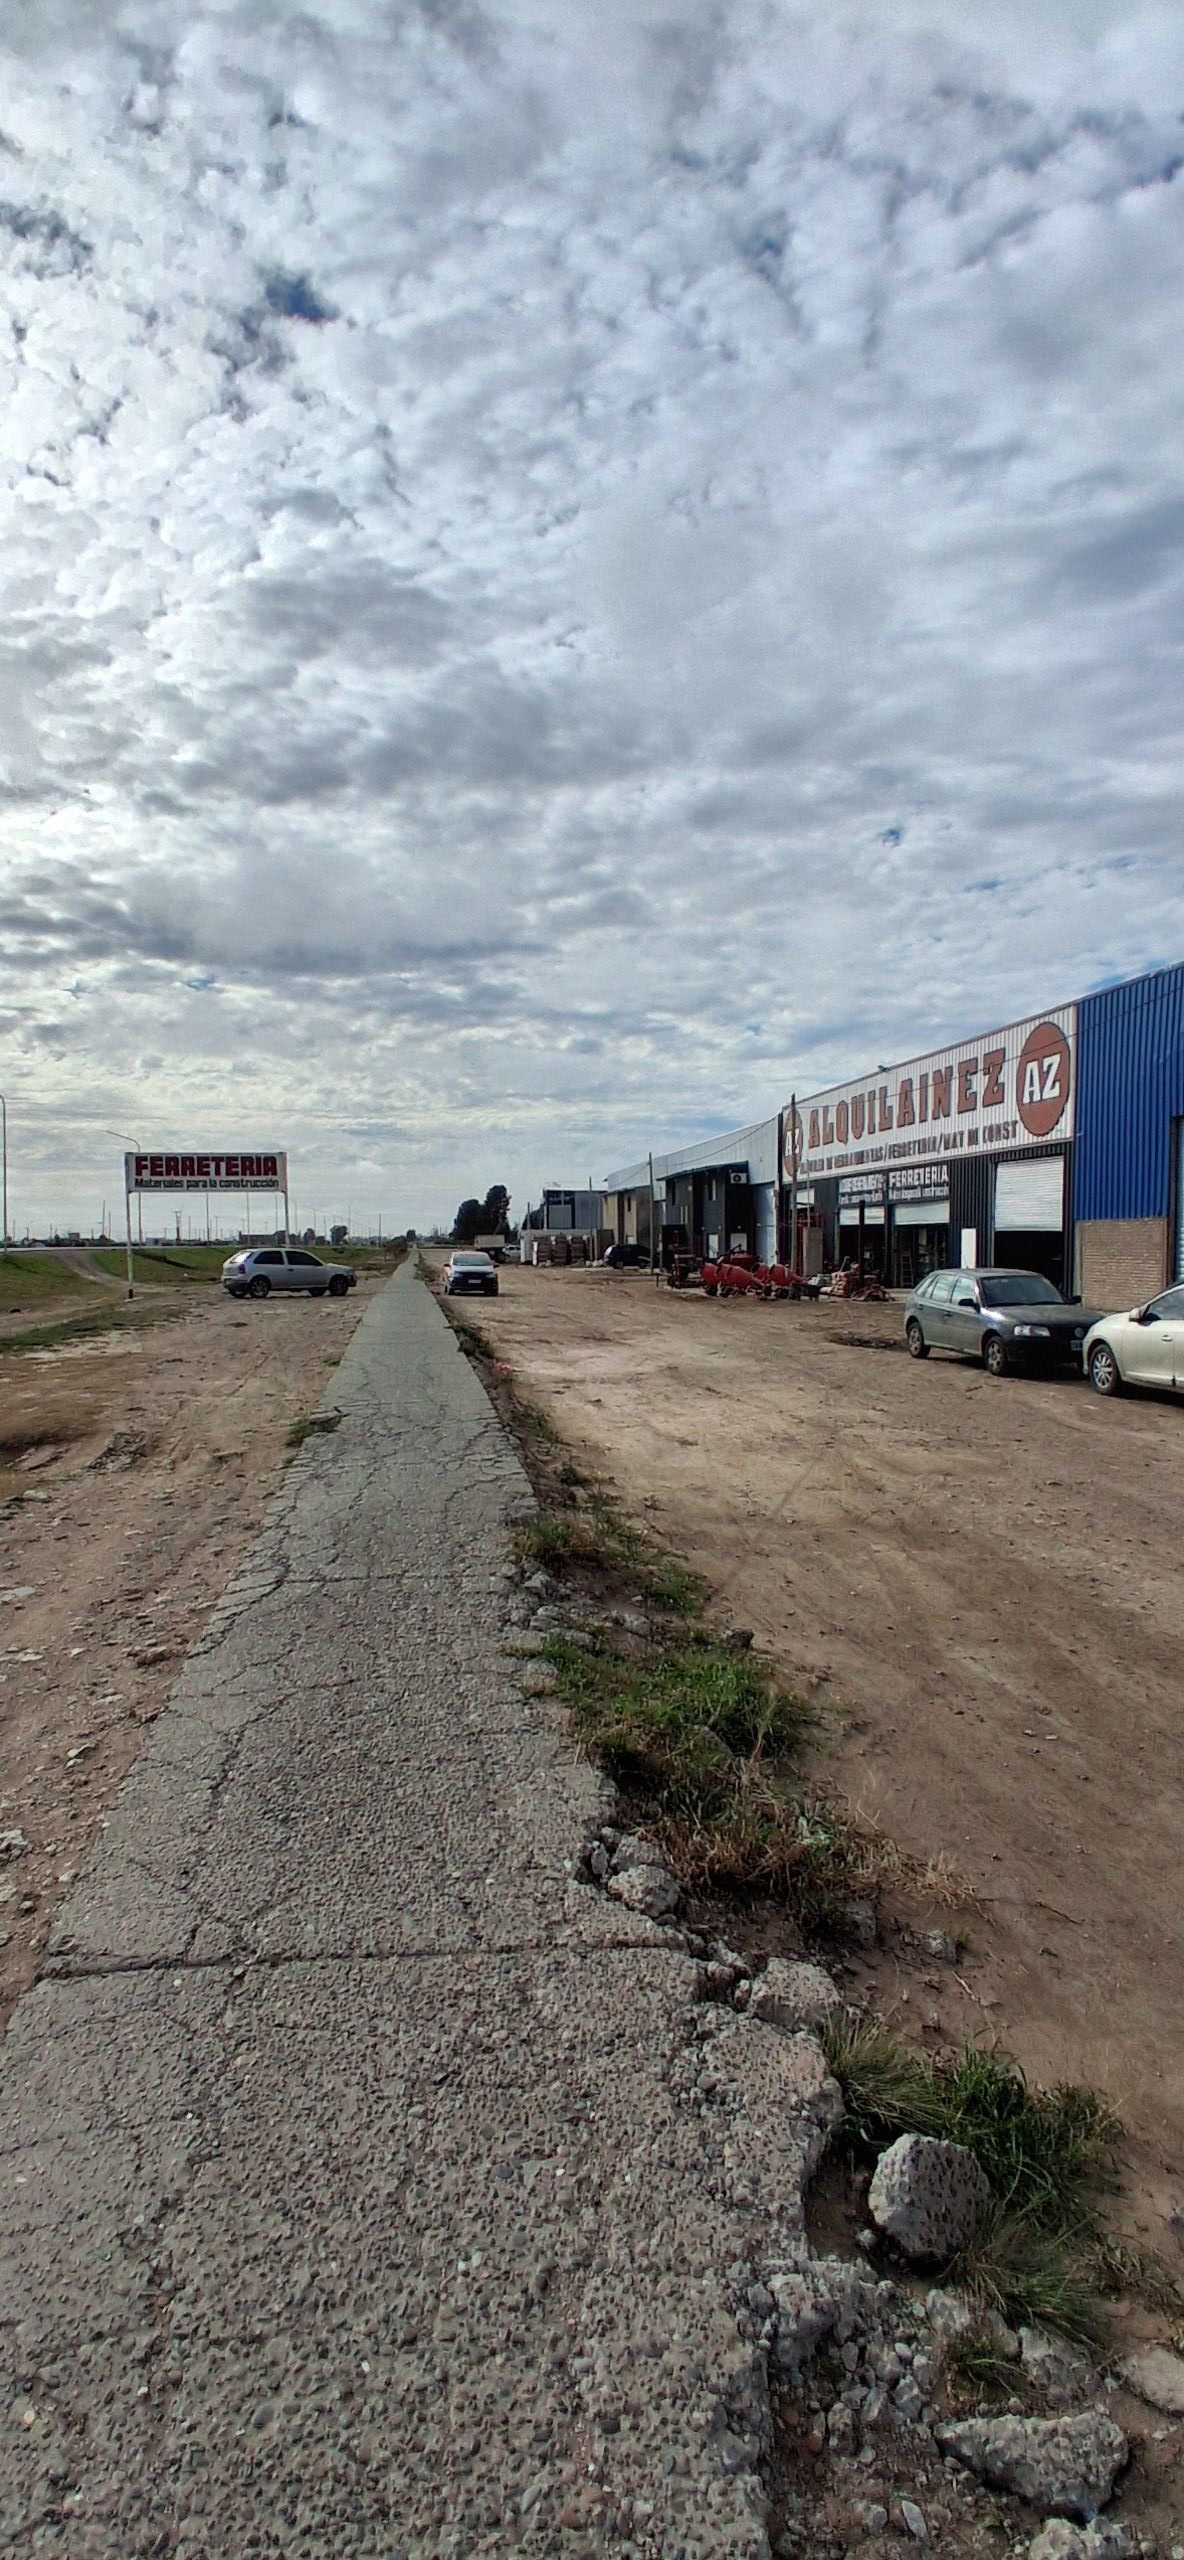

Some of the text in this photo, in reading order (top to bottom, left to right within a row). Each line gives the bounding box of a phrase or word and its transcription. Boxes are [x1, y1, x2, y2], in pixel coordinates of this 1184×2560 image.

[1022, 1053, 1062, 1105] AZ
[808, 1047, 1007, 1149] ALQUILAINEZ
[982, 1120, 1018, 1143] CONST
[134, 1155, 278, 1177] FERRETERIA
[888, 1164, 949, 1188] FERRETERIA
[134, 1178, 279, 1190] Materiales para la construcción
